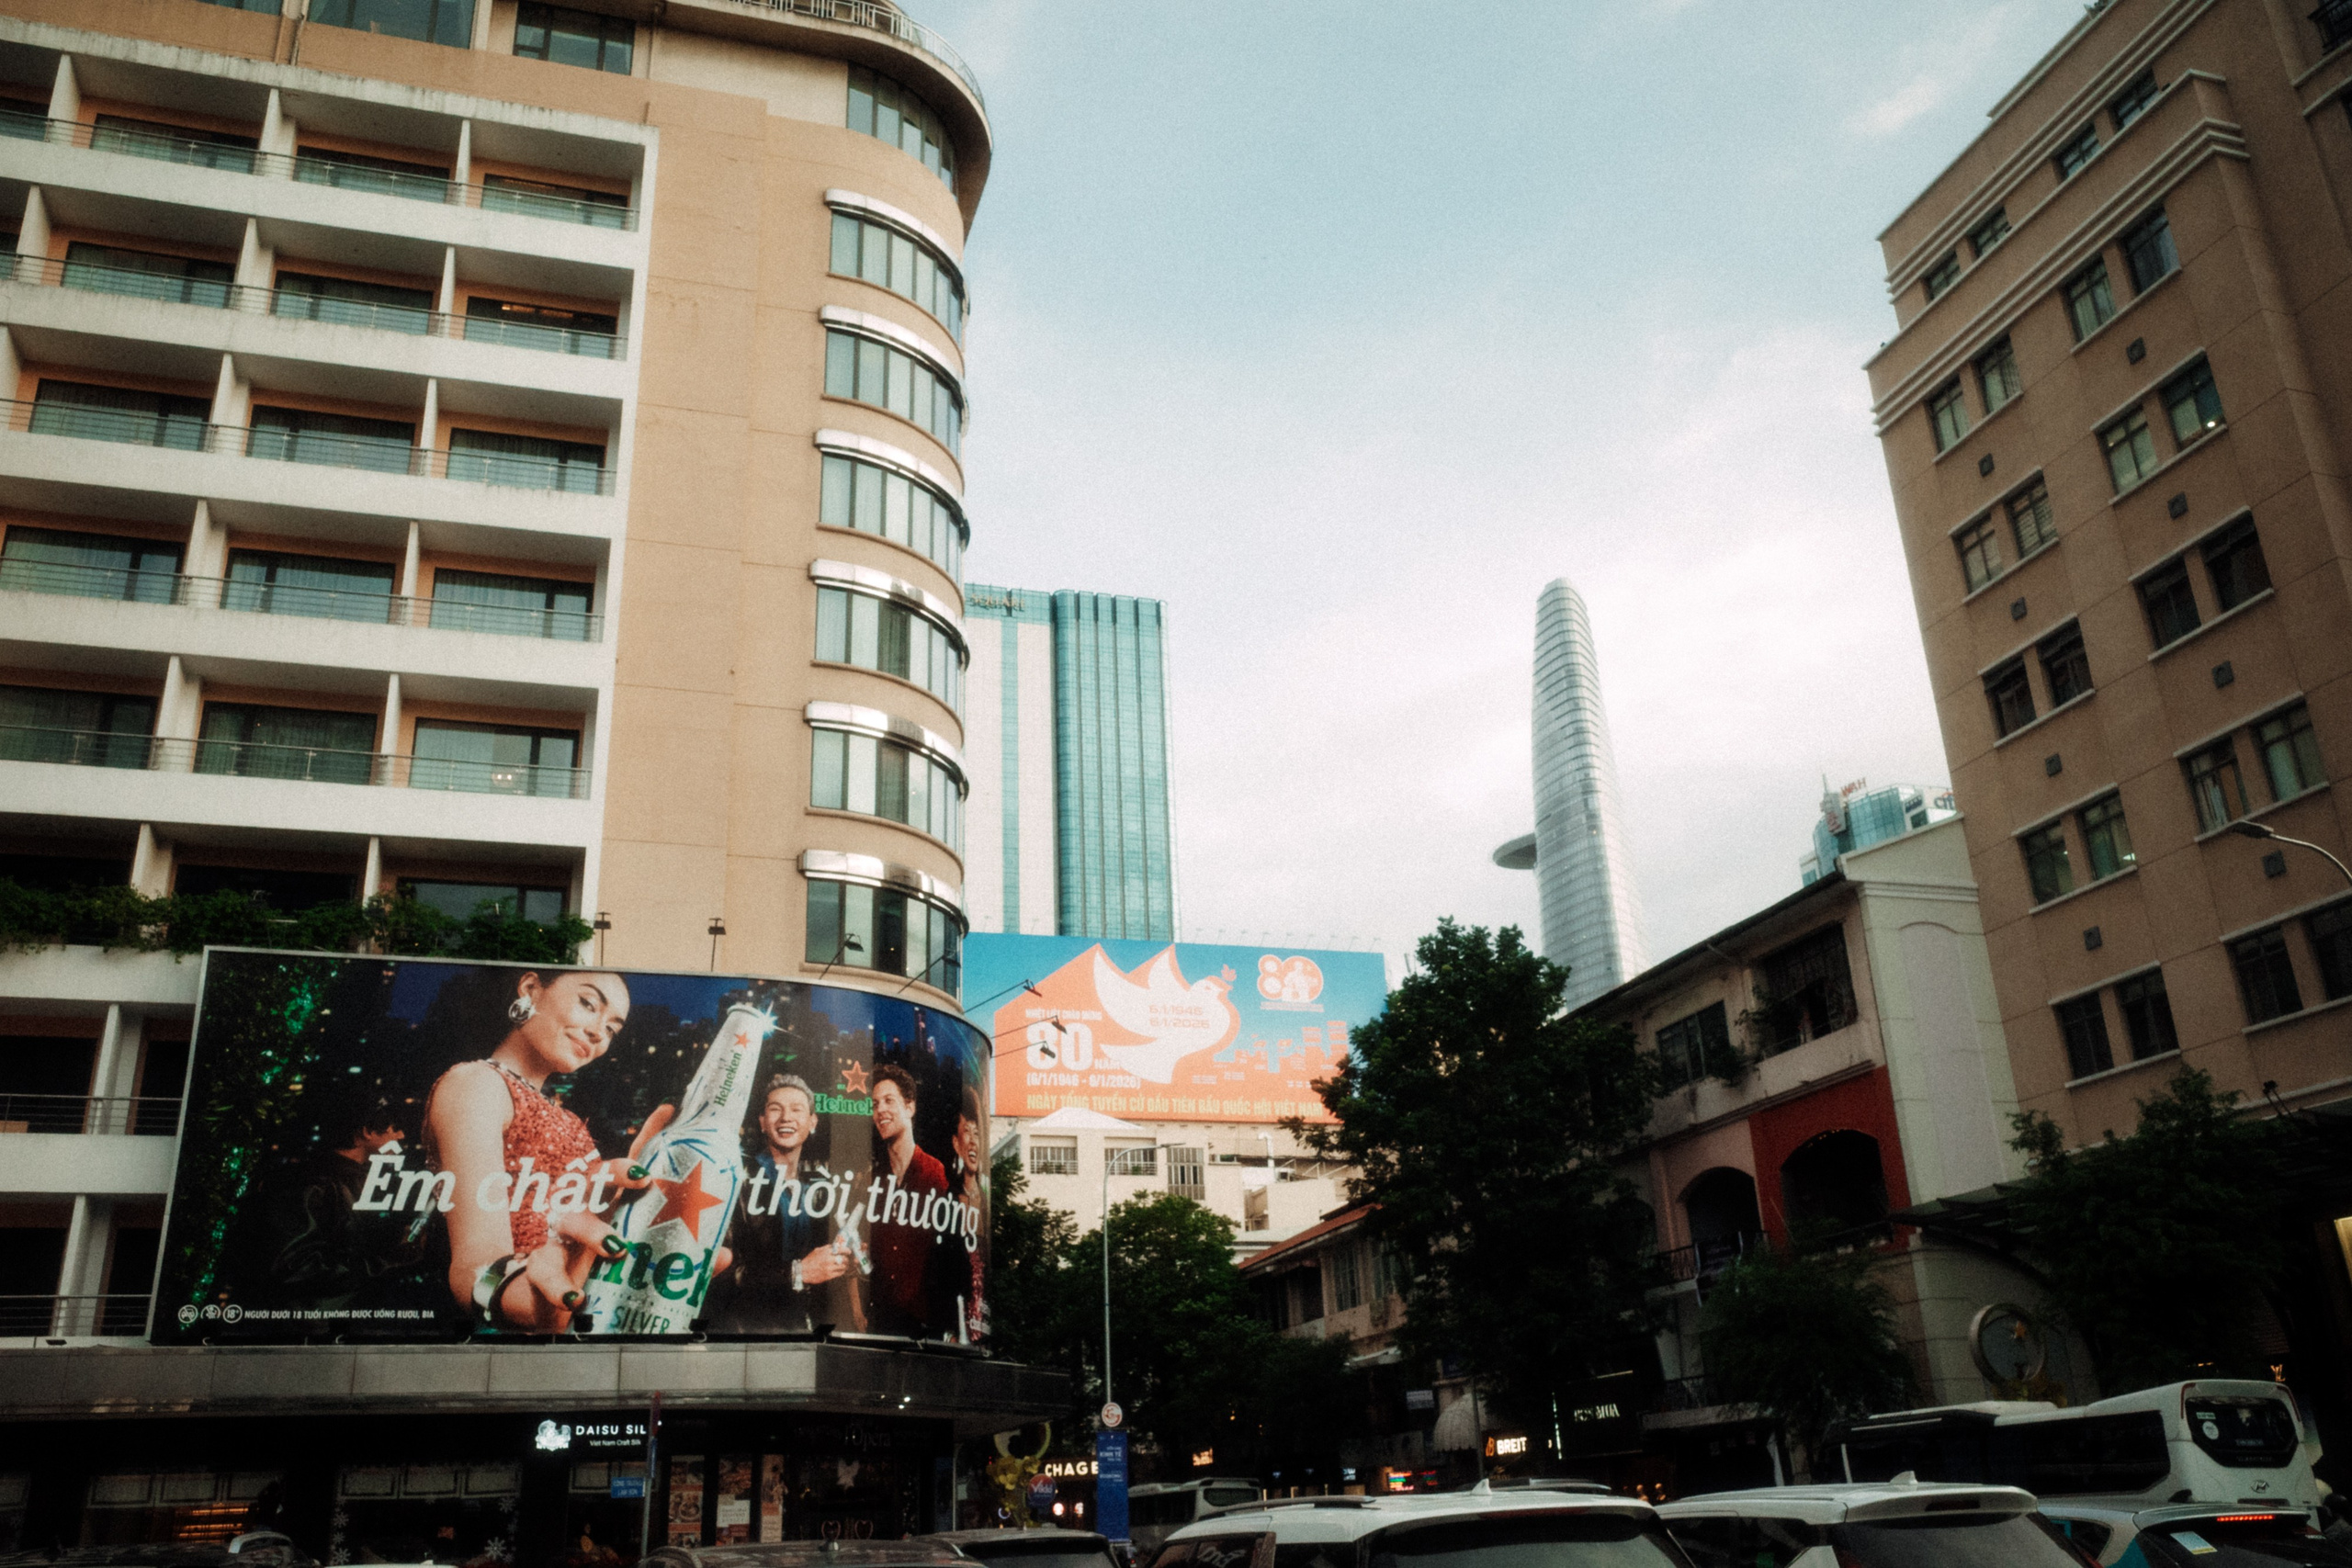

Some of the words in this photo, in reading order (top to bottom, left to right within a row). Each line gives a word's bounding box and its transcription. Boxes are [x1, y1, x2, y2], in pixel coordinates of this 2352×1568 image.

[1026, 1021, 1092, 1071] 80
[714, 1053, 741, 1107] Heineken
[1026, 1091, 1057, 1110] NGÀY
[352, 1140, 456, 1213] Êm
[477, 1147, 616, 1214] chất
[747, 1164, 854, 1220] thời
[866, 1175, 979, 1253] thượng
[293, 1309, 302, 1319] 18
[322, 1309, 350, 1319] KHÔNG
[422, 1309, 435, 1319] BIA
[610, 1305, 671, 1334] SILVER
[575, 1425, 620, 1436] DAISU
[626, 1424, 648, 1436] SIL
